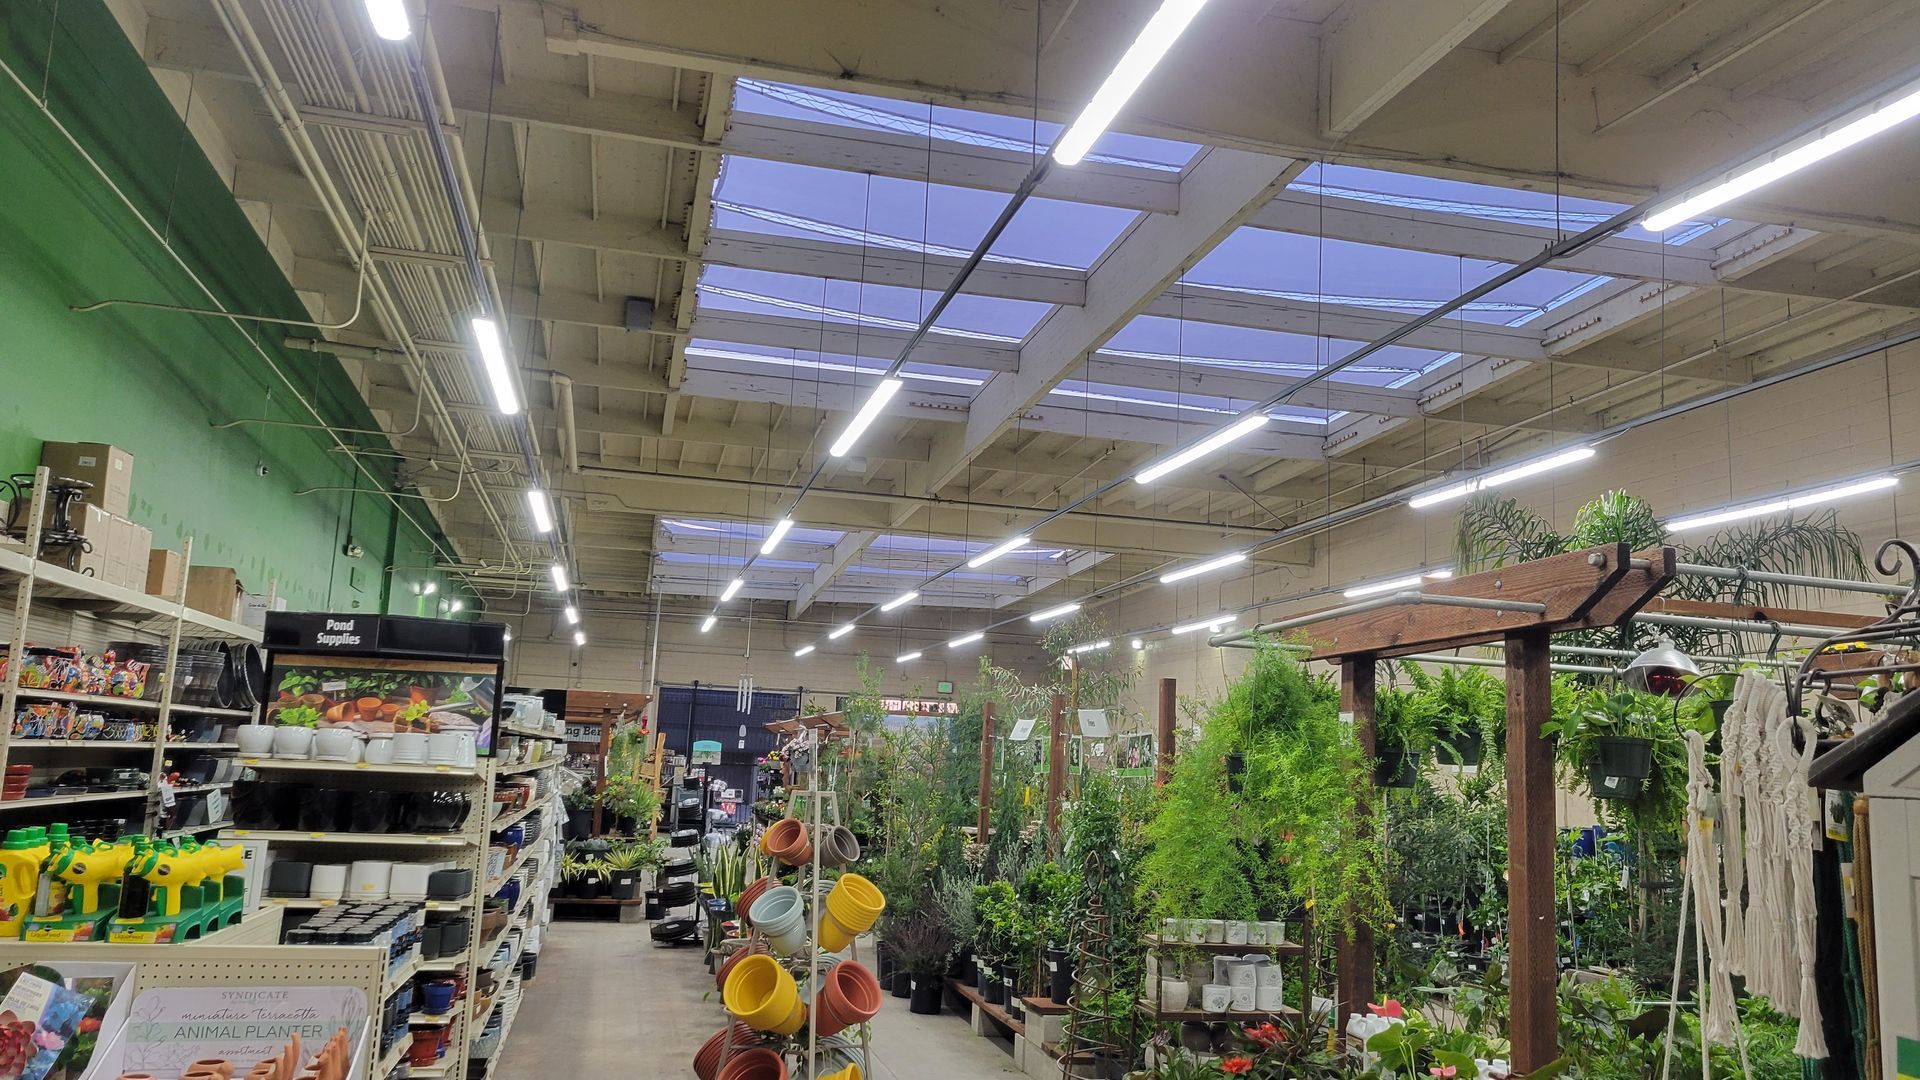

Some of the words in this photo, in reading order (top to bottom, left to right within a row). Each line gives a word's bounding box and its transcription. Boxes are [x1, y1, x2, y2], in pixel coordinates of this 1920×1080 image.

[326, 619, 354, 631] Pond
[316, 632, 361, 646] Supplies
[221, 991, 289, 1000] SYNDICATE
[181, 1007, 249, 1021] miniature
[174, 1025, 241, 1039] ANIMAL
[245, 1024, 323, 1039] PLANTER
[218, 1045, 274, 1056] assortment
